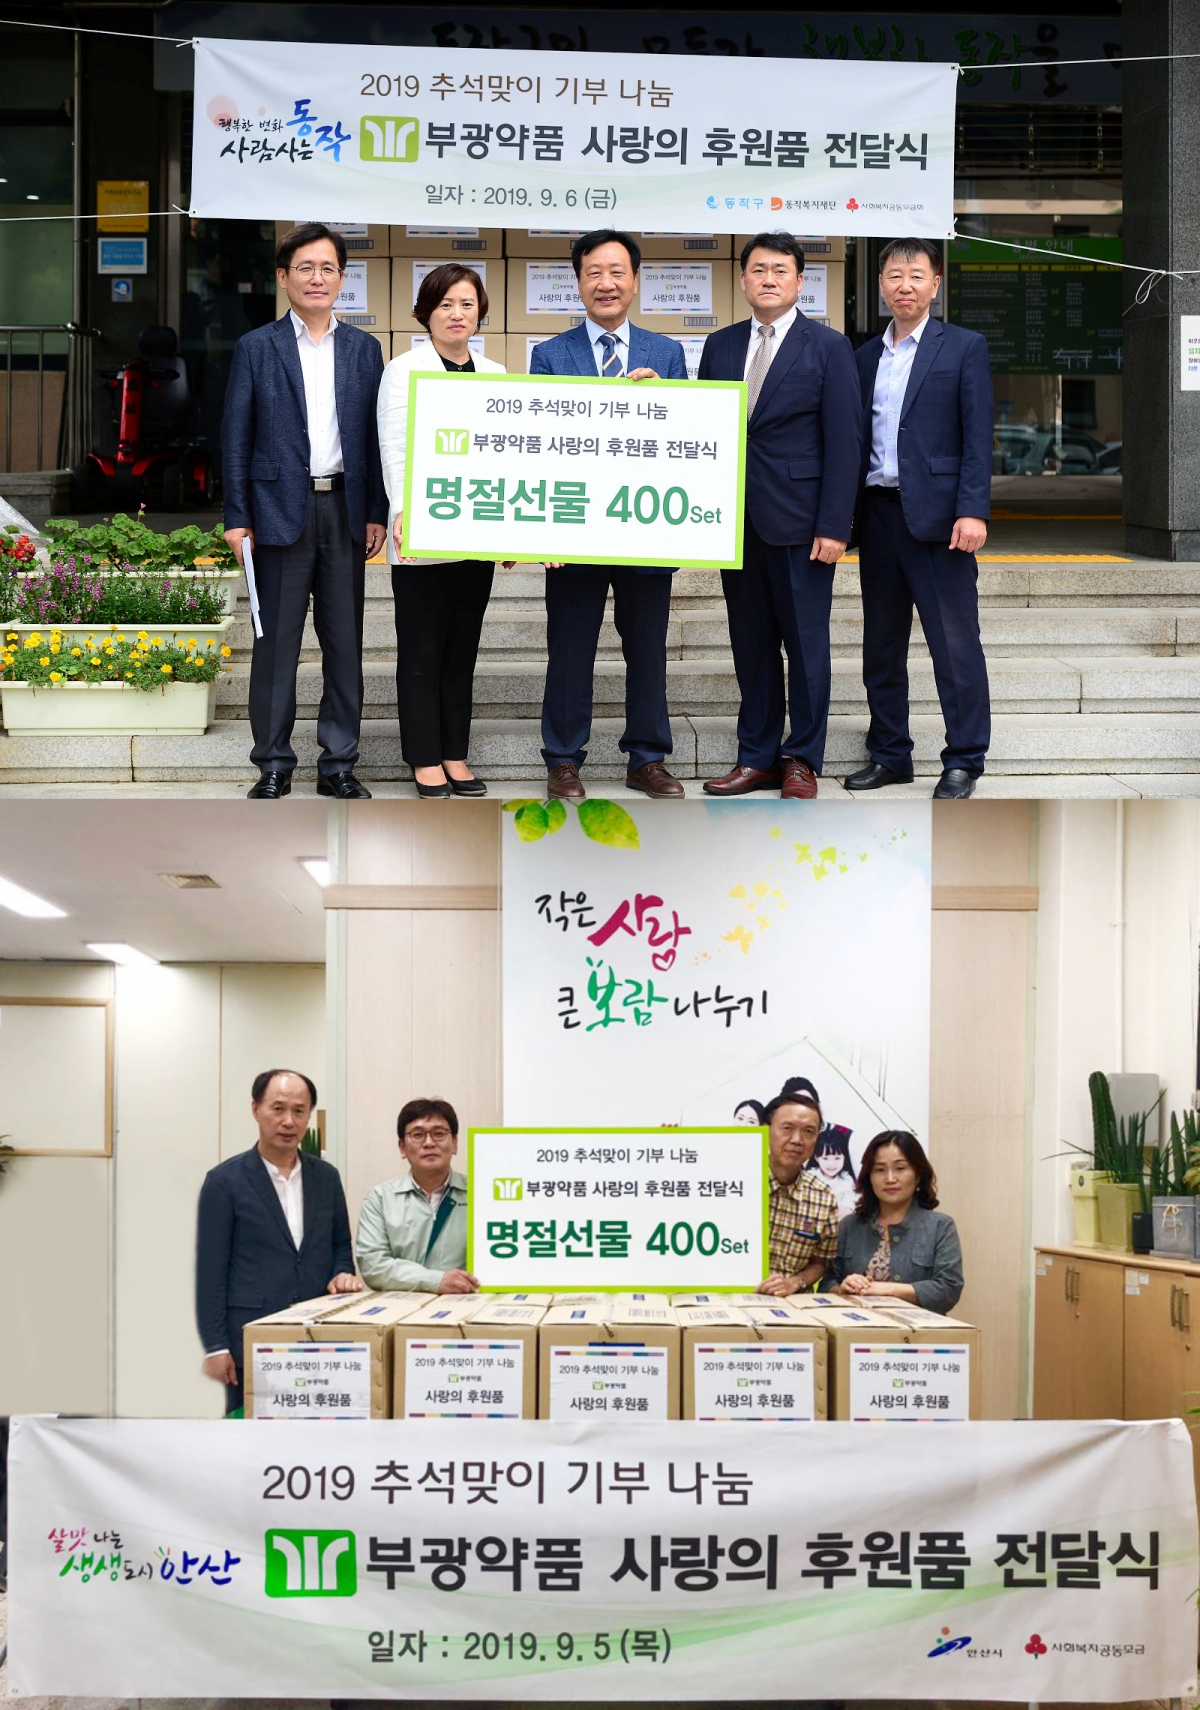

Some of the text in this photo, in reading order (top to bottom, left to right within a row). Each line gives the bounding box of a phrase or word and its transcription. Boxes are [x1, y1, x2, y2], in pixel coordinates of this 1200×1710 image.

[361, 73, 673, 107] 2019 추석맞이 기부 나눔
[218, 117, 284, 133] 행복한 변화
[285, 98, 351, 163] 동작
[219, 136, 315, 164] 사람사는
[426, 122, 927, 170] 부광약품 사랑의 후원품 전달식
[426, 185, 464, 205] 일자
[484, 187, 532, 206] 2019.
[541, 189, 557, 207] 9.
[566, 189, 577, 207] 6
[585, 188, 617, 210] (금)
[725, 198, 763, 210] 동작구
[785, 200, 836, 210] 동작복지재단
[1046, 239, 1074, 253] 안내
[539, 294, 581, 303] 사랑의 후원
[652, 294, 700, 303] 사랑의 후원품
[486, 399, 668, 420] 2019 추석맞이 기부 나눔
[474, 434, 717, 460] 부광약품 사랑의 후원품 전달식
[426, 477, 721, 525] 명절선물 400Set
[535, 890, 692, 971] 작은 사랑
[557, 956, 768, 1032] 큰 보람 나누기
[537, 1148, 698, 1163] 2019 추석맞이 기부 나눔
[527, 1180, 743, 1197] 부광약품 사랑의 후원품 전달식
[487, 1220, 748, 1259] 명절선물 400Set
[261, 1361, 362, 1371] 2019 추석맞이 기부 나눔
[415, 1357, 514, 1368] 2019 추석맞이 기부 나눔
[560, 1365, 659, 1375] 2019 추석맞이 기부 나눔
[704, 1361, 804, 1371] 2019 추석맞이 기부 나눔
[859, 1362, 960, 1373] 2019 추석맞이 기부 나눔
[272, 1392, 351, 1407] 사랑의 후원품
[425, 1390, 504, 1404] 사랑의 후원품
[570, 1398, 649, 1411] 사랑의 후원품
[715, 1394, 794, 1408] 사랑의 후원품
[870, 1395, 949, 1409] 사랑의 후원품
[263, 1460, 753, 1505] 2019 추석맞이 기부 나눔
[161, 1550, 241, 1585] 안산
[366, 1530, 1159, 1592] 부광약품 사랑의 후원품 전달식
[368, 1630, 428, 1663] 일자
[464, 1632, 549, 1661] 2019.
[556, 1632, 583, 1661] 9.
[594, 1632, 613, 1660] 5
[616, 1626, 674, 1663] (목)
[966, 1649, 1002, 1658] 안산시
